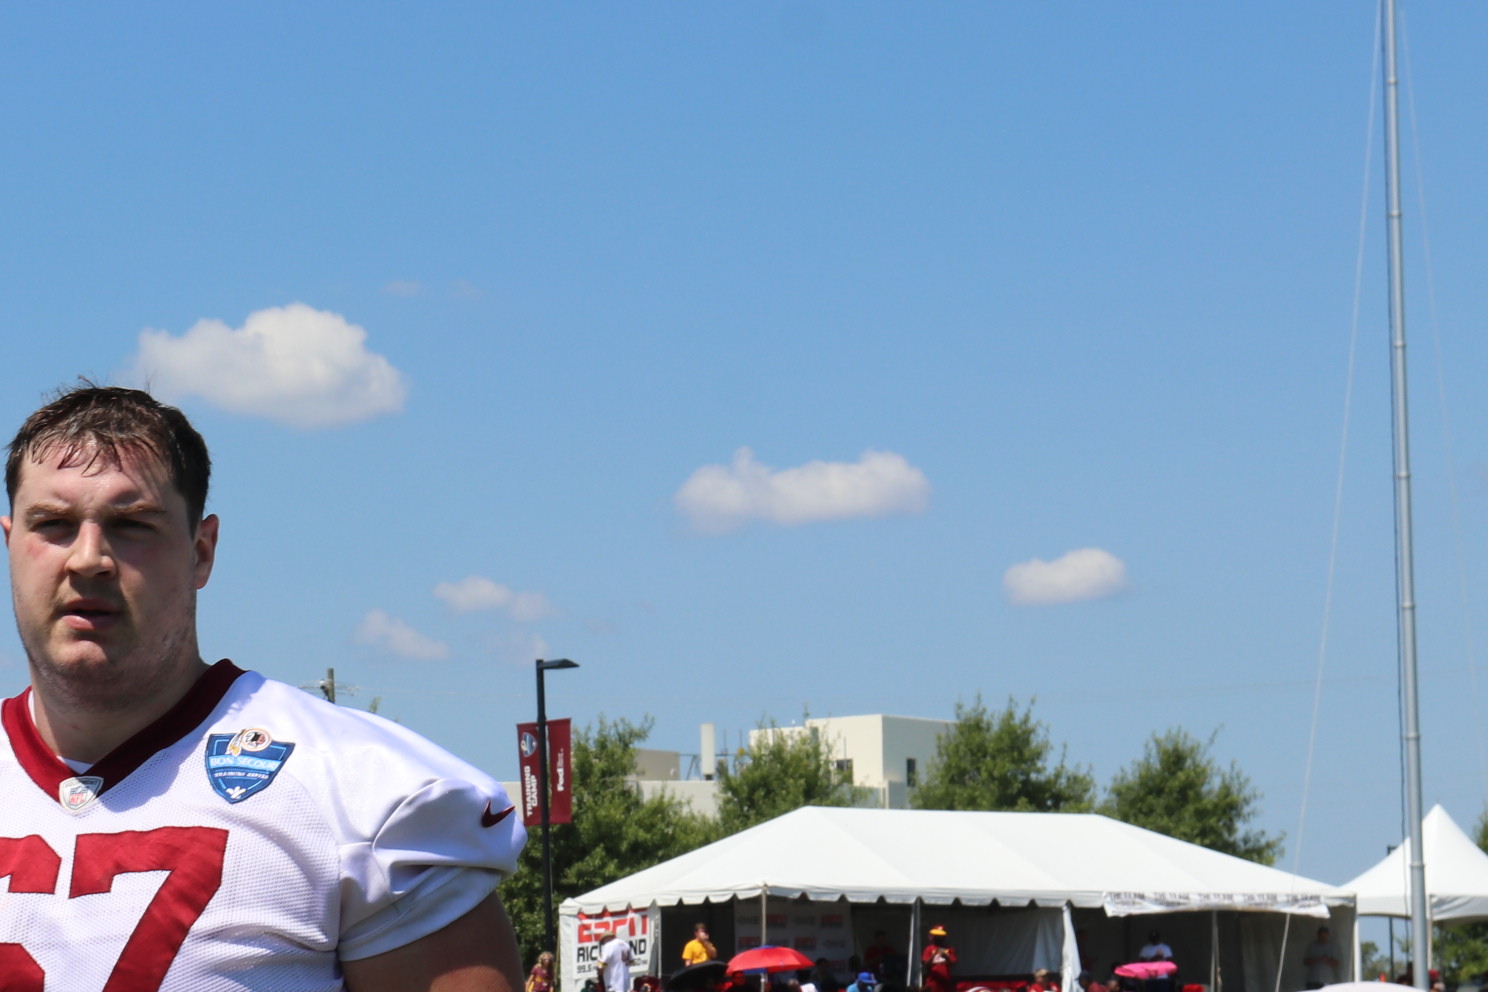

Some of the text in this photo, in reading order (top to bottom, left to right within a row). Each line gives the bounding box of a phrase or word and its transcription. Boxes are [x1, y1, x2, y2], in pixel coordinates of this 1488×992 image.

[524, 765, 533, 817] TRAINING
[578, 915, 648, 944] ESPN
[577, 939, 647, 963] RICND
